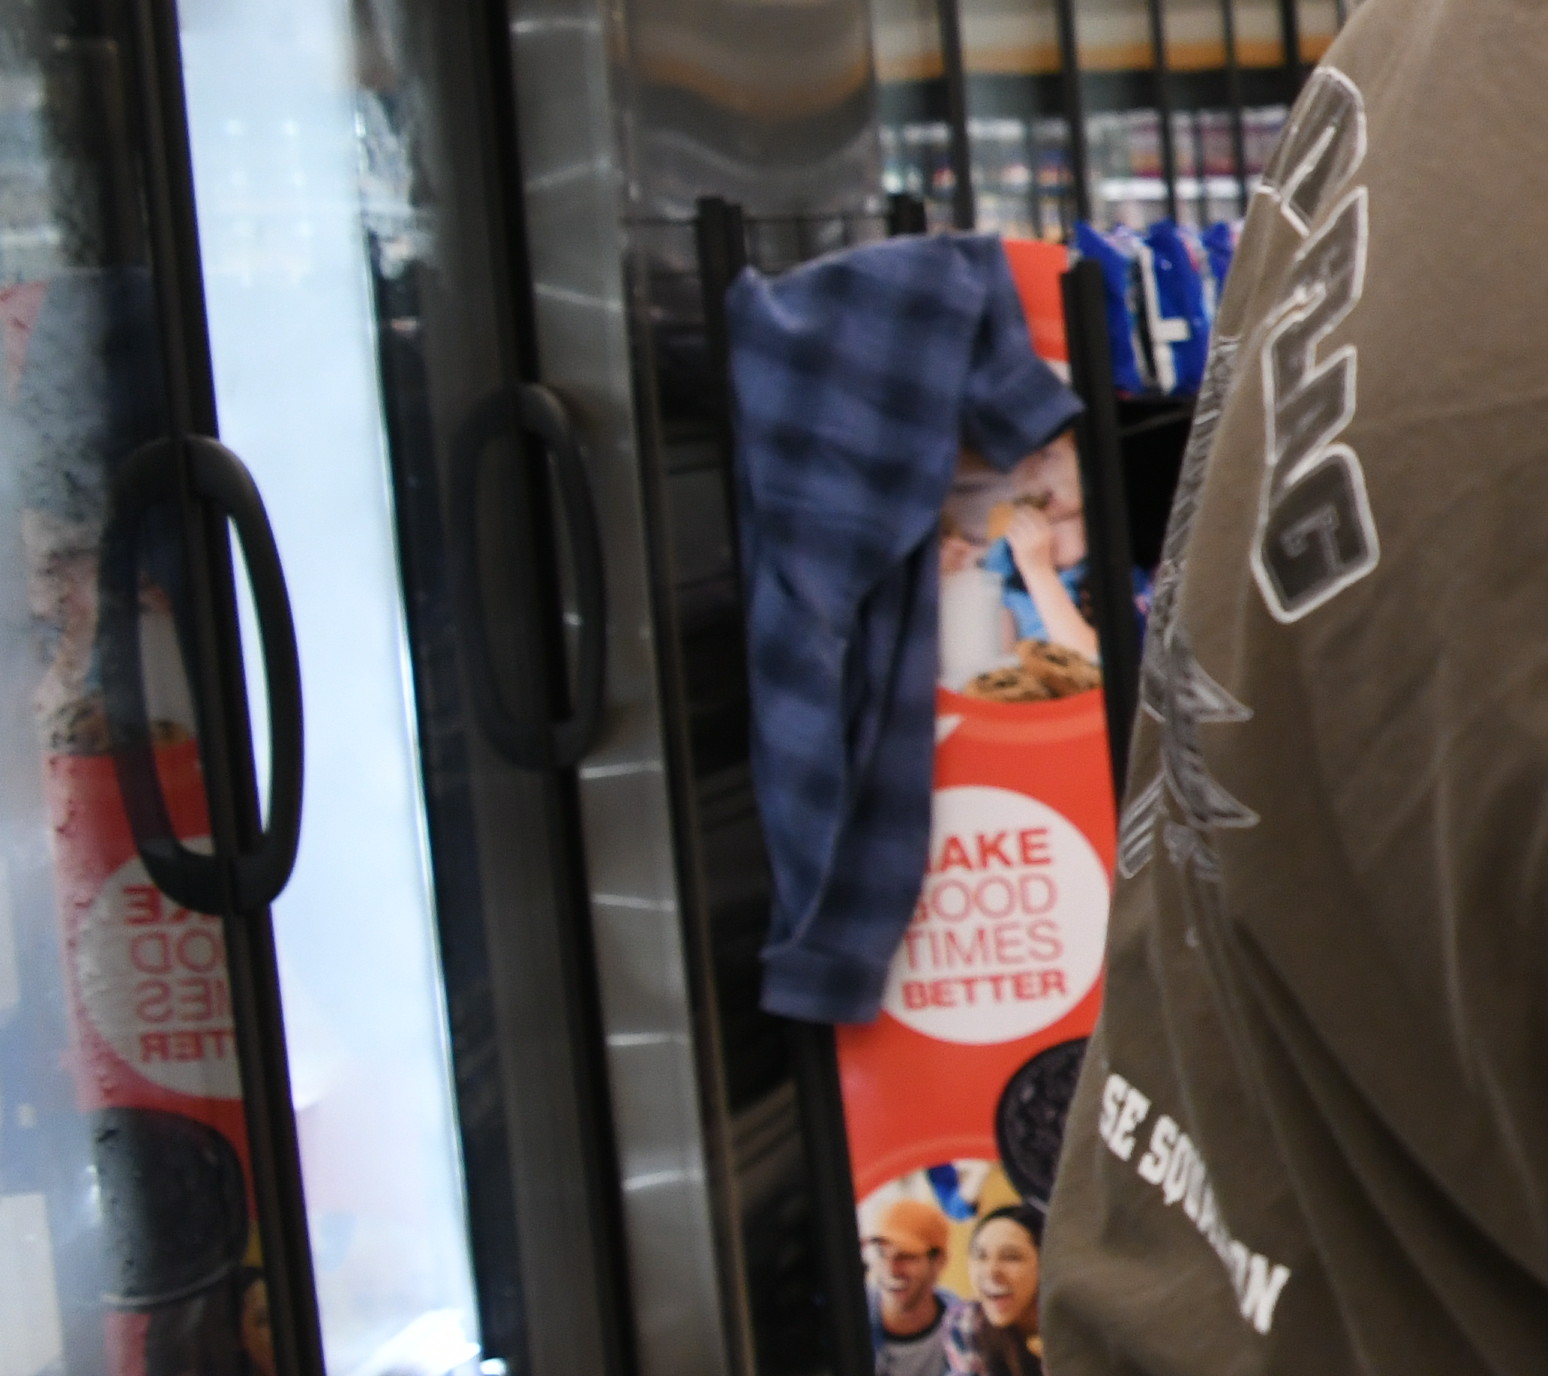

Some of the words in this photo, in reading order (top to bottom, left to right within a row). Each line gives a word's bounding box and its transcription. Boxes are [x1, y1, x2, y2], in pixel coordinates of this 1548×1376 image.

[926, 829, 1052, 875] AKE
[915, 873, 1057, 923] OOD
[904, 920, 1063, 969] TIMES
[902, 970, 1066, 1009] BETTER
